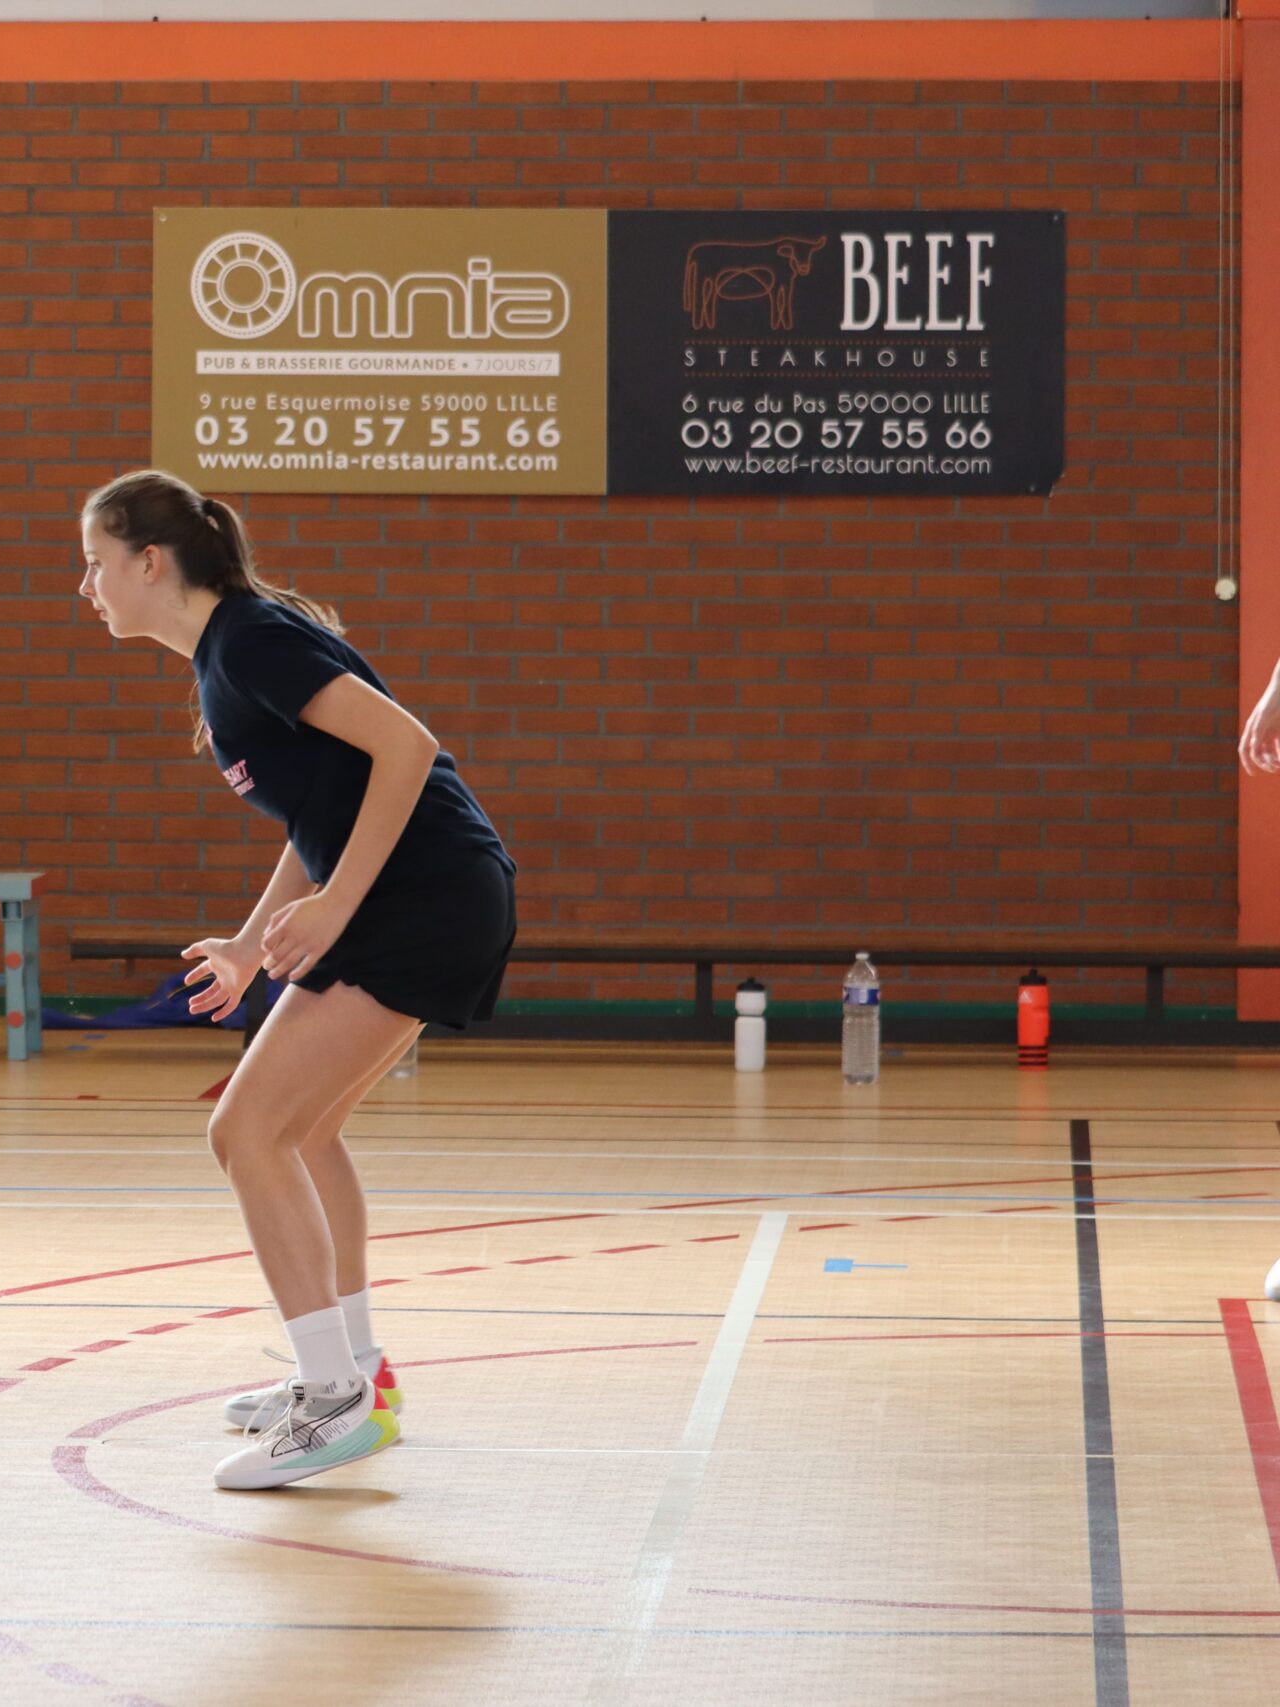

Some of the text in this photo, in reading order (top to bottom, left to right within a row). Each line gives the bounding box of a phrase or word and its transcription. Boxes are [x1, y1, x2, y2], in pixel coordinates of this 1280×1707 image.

[840, 233, 995, 331] BEEF
[203, 356, 236, 370] PUB
[240, 357, 251, 370] &
[256, 357, 343, 370] BRASSERIE
[348, 357, 455, 371] GOURMANDE
[684, 348, 988, 368] STEAKHOUSE
[199, 392, 557, 414] 9 rue Esquermoise 59000 LILLE
[682, 393, 990, 414] 6 rue du Pas 59000 LILLE
[194, 415, 561, 448] 03 20 57 55 66
[681, 419, 992, 449] 03 20 57 55 66
[197, 449, 558, 471] www.omnia-restaurant.com
[684, 450, 991, 475] www.beef-restaurant.com
